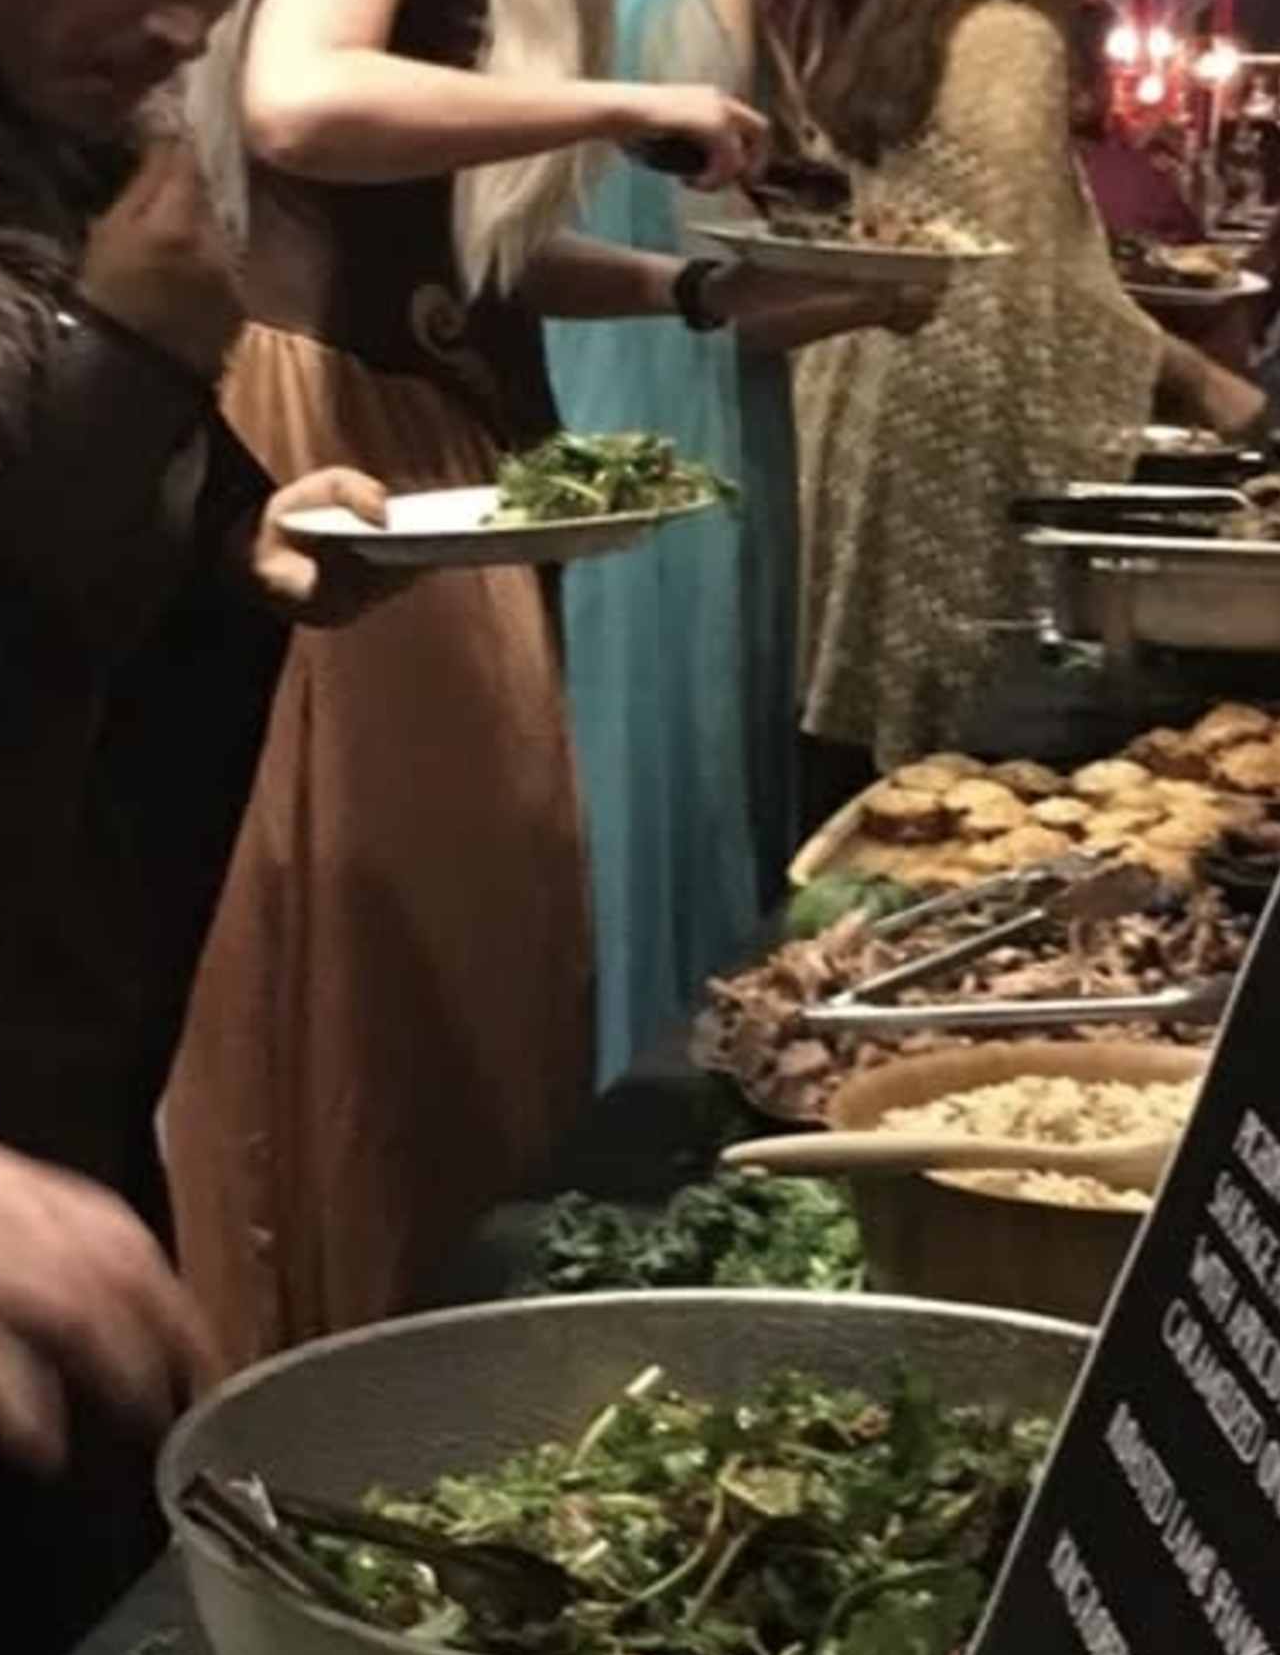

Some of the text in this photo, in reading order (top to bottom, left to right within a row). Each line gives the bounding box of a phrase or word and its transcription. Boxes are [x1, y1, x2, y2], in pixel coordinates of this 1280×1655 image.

[1189, 1236, 1238, 1323] WITH
[1105, 1402, 1175, 1526] ROASTED
[1161, 1499, 1217, 1597] LAMB
